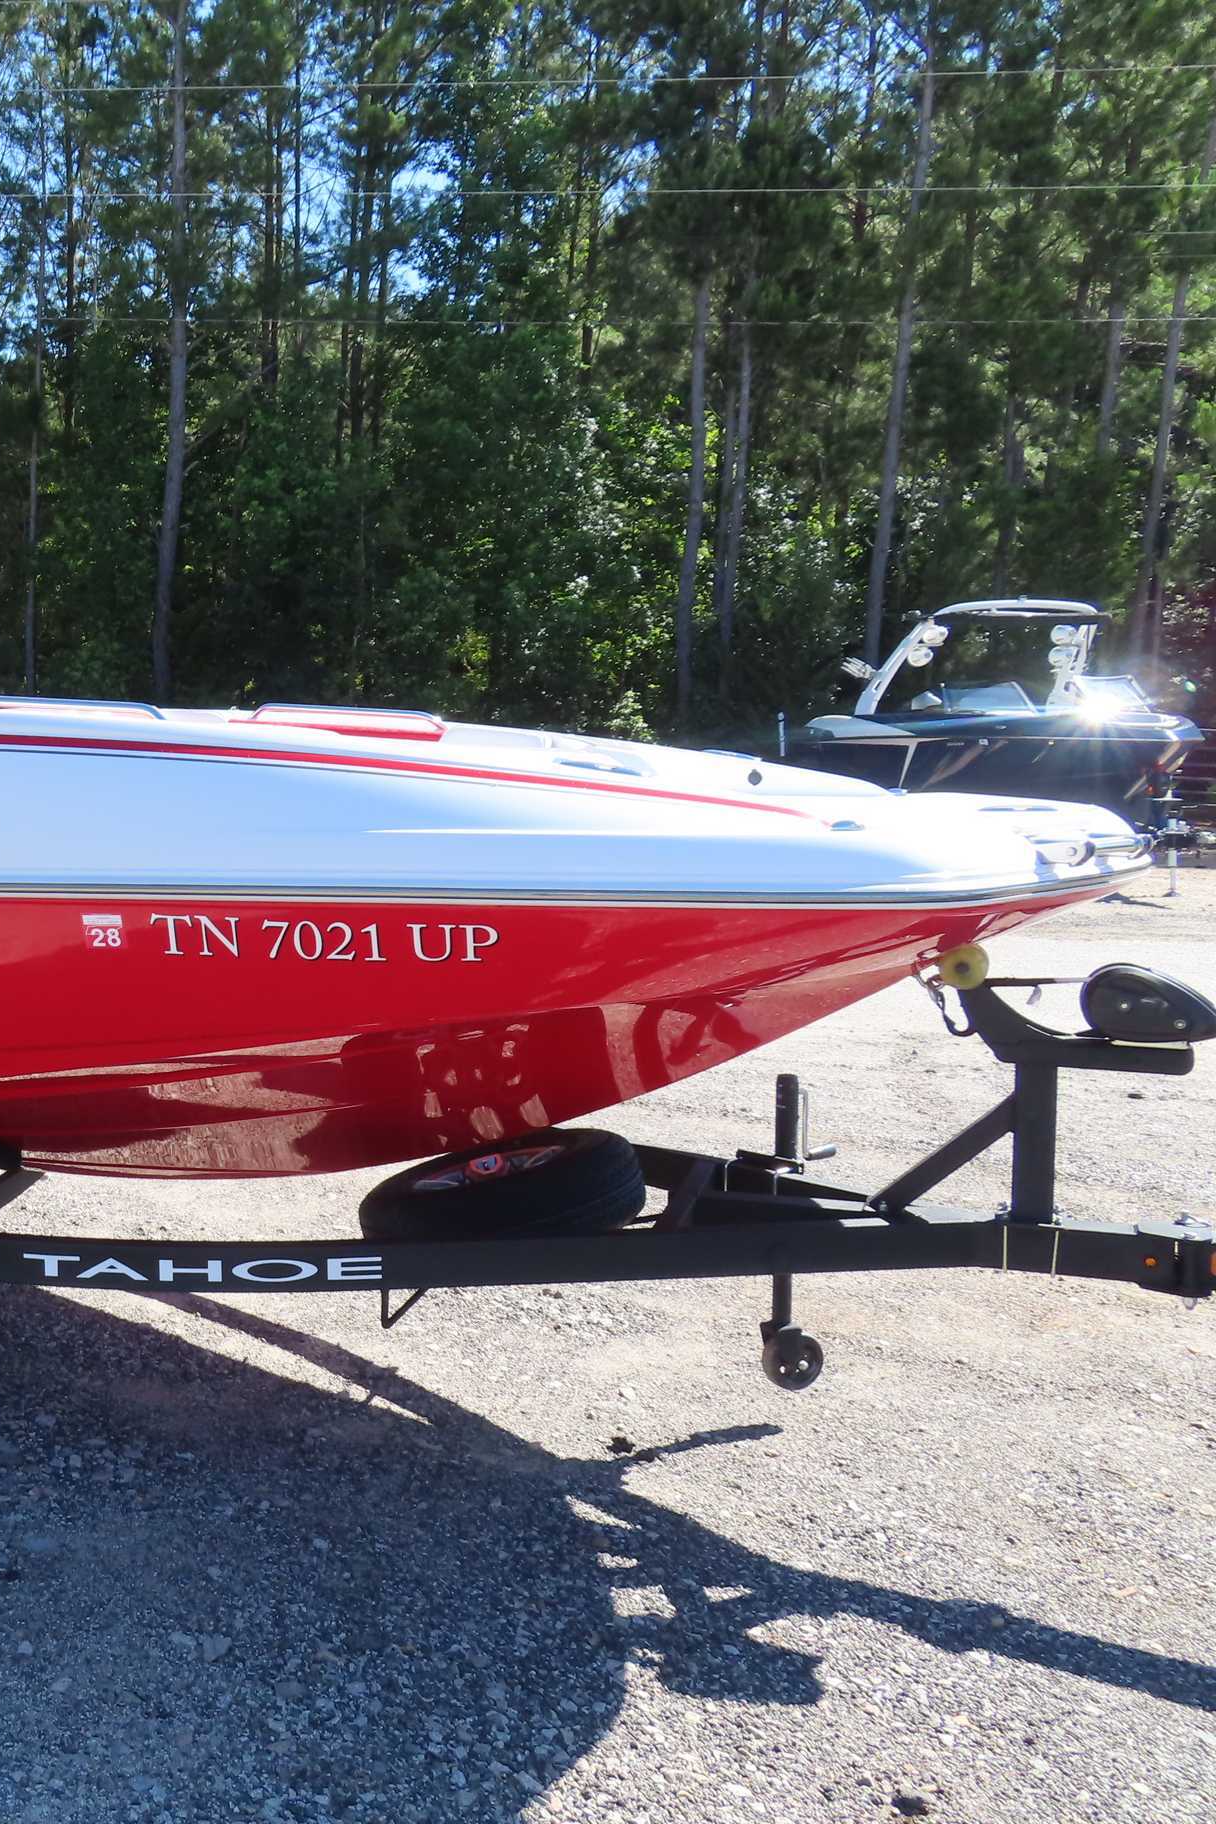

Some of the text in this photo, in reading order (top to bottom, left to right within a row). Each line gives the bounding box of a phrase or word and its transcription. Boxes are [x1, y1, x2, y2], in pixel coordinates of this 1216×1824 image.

[91, 928, 122, 947] 28
[150, 912, 500, 962] TN 7021 UP
[23, 1253, 383, 1282] TAHOE
